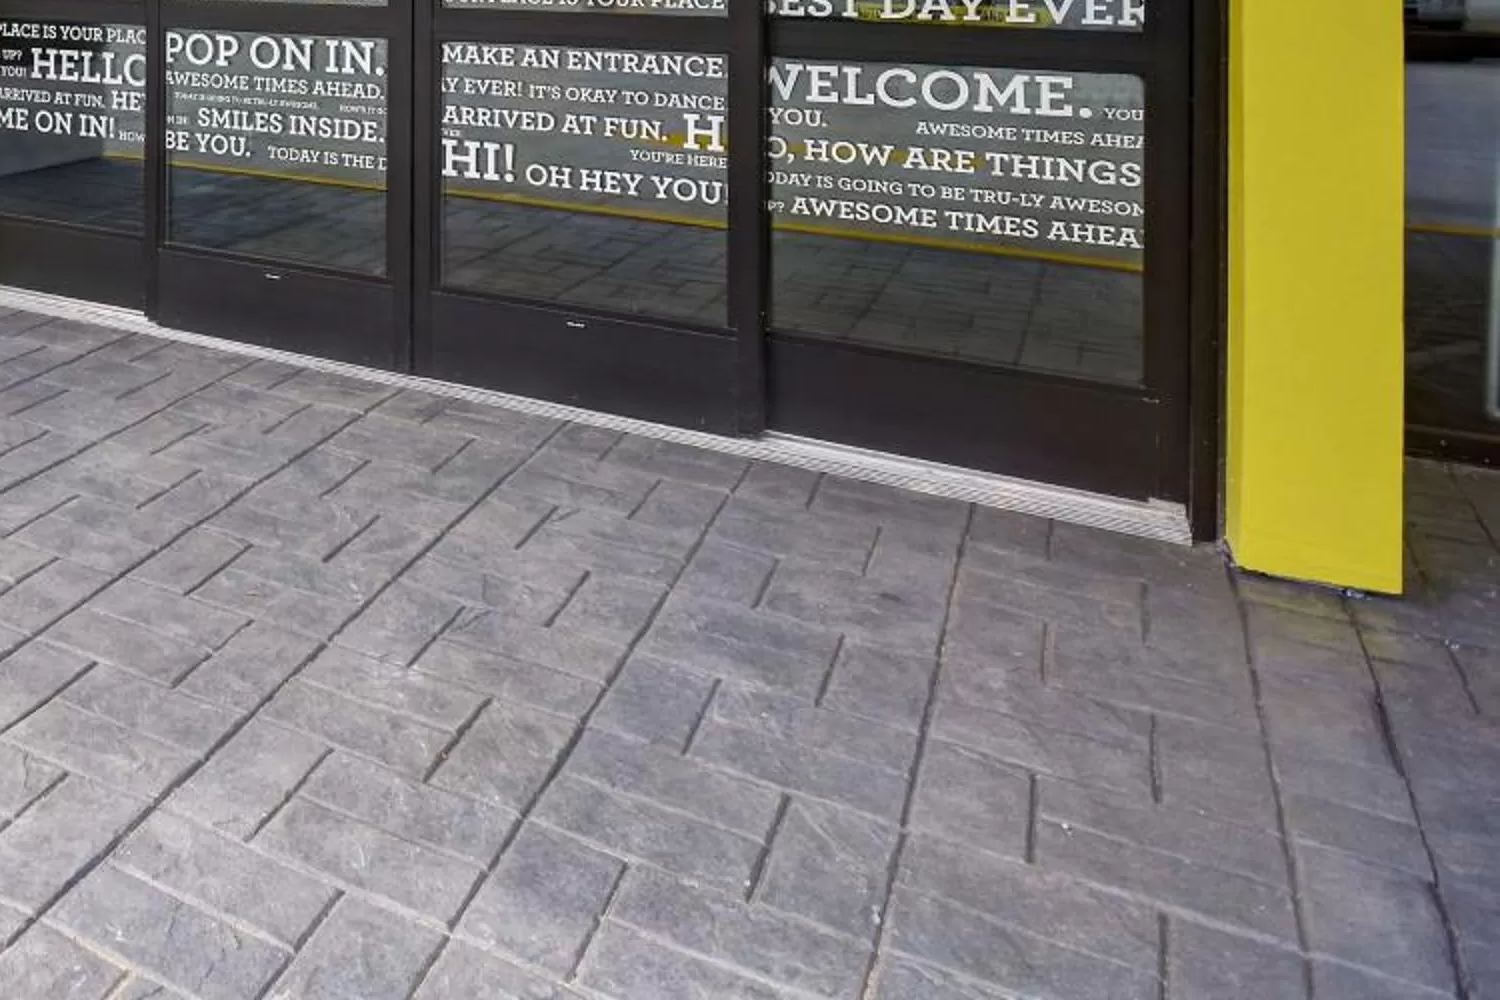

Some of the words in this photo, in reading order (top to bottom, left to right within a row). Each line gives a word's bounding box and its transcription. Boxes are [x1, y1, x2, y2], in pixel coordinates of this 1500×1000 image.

[42, 24, 57, 40] IS
[59, 26, 104, 42] YOUR
[166, 31, 239, 67] POP
[250, 36, 314, 72] ON
[325, 40, 386, 77] IN.
[442, 44, 515, 66] MAKE
[520, 48, 560, 69] AN
[54, 91, 73, 106] AT
[74, 94, 106, 109] FUN.
[111, 90, 147, 111] HE
[253, 76, 309, 95] TIMES
[312, 81, 386, 100] AHEAD.
[464, 78, 523, 97] EVER!
[529, 84, 561, 100] IT'S
[566, 86, 618, 104] OKAY
[622, 91, 650, 105] TO
[654, 93, 726, 111] DANCE
[35, 110, 73, 136] ON
[79, 113, 115, 139] IN!
[197, 107, 283, 134] SMILES
[289, 115, 386, 144] INSIDE.
[442, 105, 555, 132] ARRIVED
[560, 114, 597, 136] AT
[604, 117, 668, 142] FUN.
[683, 112, 725, 152] H
[768, 107, 828, 128] YOU.
[916, 121, 1017, 141] AWESOME
[1021, 128, 1085, 145] TIMES
[1102, 108, 1145, 121] YOU
[166, 130, 190, 151] BE
[196, 132, 251, 158] YOU.
[268, 146, 322, 164] TODAY
[324, 151, 339, 166] IS
[341, 153, 375, 170] THE
[630, 150, 684, 164] YOU'RE
[687, 154, 728, 168] HERE
[804, 138, 894, 168] HOW
[902, 146, 976, 174] ARE
[985, 152, 1142, 187] THINGS
[442, 138, 515, 183] HI!
[525, 163, 572, 188] OH
[580, 168, 644, 196] HEY
[816, 176, 834, 189] IS
[838, 177, 903, 195] GOING
[907, 184, 935, 198] TO
[940, 186, 965, 200] BE
[969, 189, 1046, 208] TRU-LY
[790, 197, 938, 228] AWESOME
[944, 210, 1040, 238] TIMES
[1047, 220, 1145, 249] AHEA
